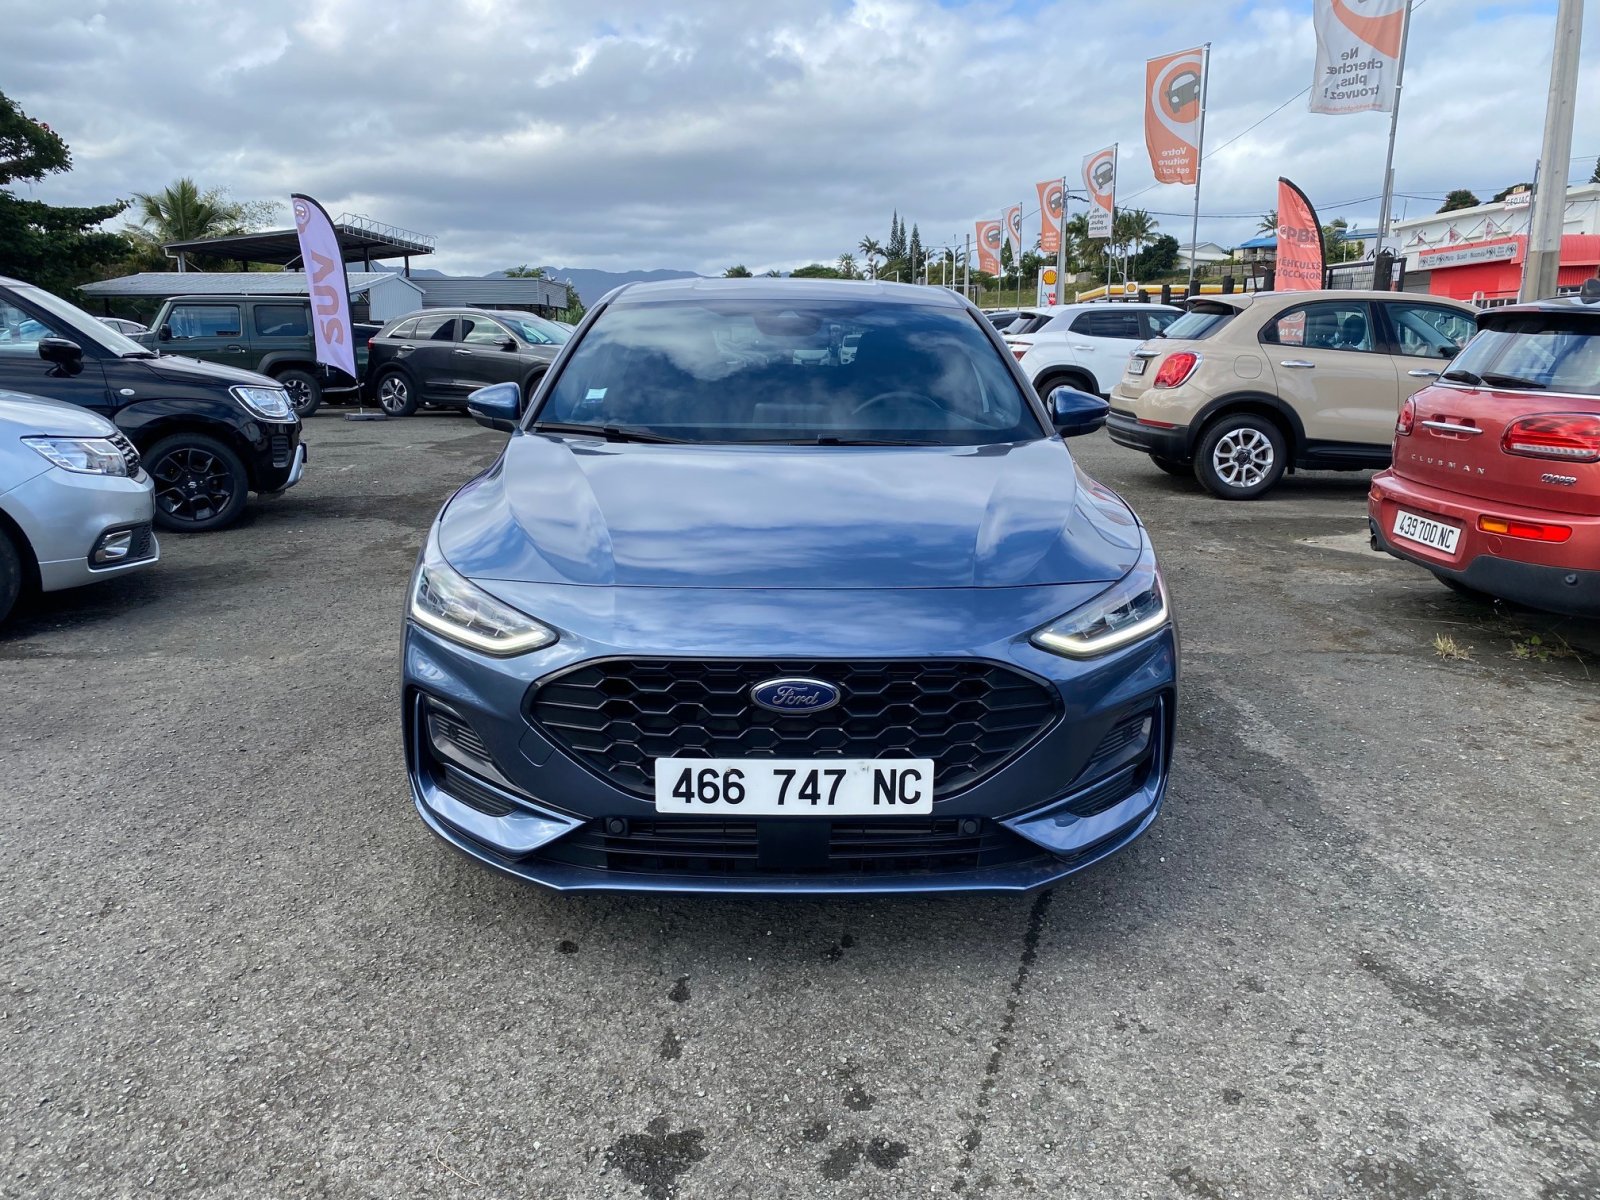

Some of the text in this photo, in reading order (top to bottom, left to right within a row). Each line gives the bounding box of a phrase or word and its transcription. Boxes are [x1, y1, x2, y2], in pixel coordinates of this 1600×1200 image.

[311, 249, 344, 345] SUV
[1411, 453, 1486, 475] CLUBMAN
[1541, 473, 1577, 487] COOPER
[1399, 515, 1455, 549] 439 700 NC
[772, 685, 820, 705] Ford
[672, 767, 922, 806] 466 747 NC
